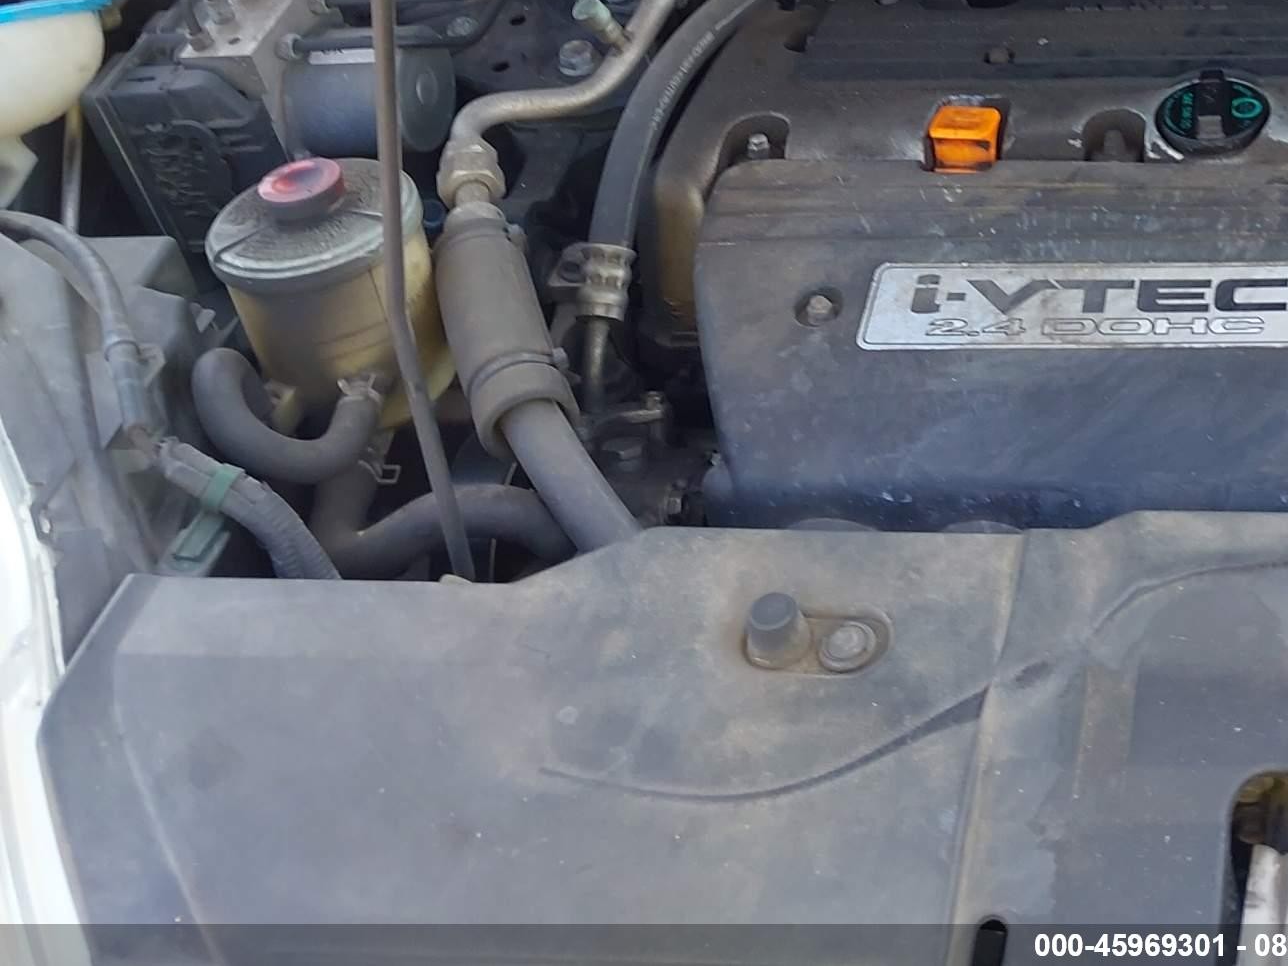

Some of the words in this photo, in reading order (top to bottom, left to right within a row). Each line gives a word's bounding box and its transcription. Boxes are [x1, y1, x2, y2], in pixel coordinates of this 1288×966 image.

[911, 274, 1288, 315] i-VTEC
[925, 318, 1026, 336] 2.4
[1040, 317, 1265, 335] DOHC
